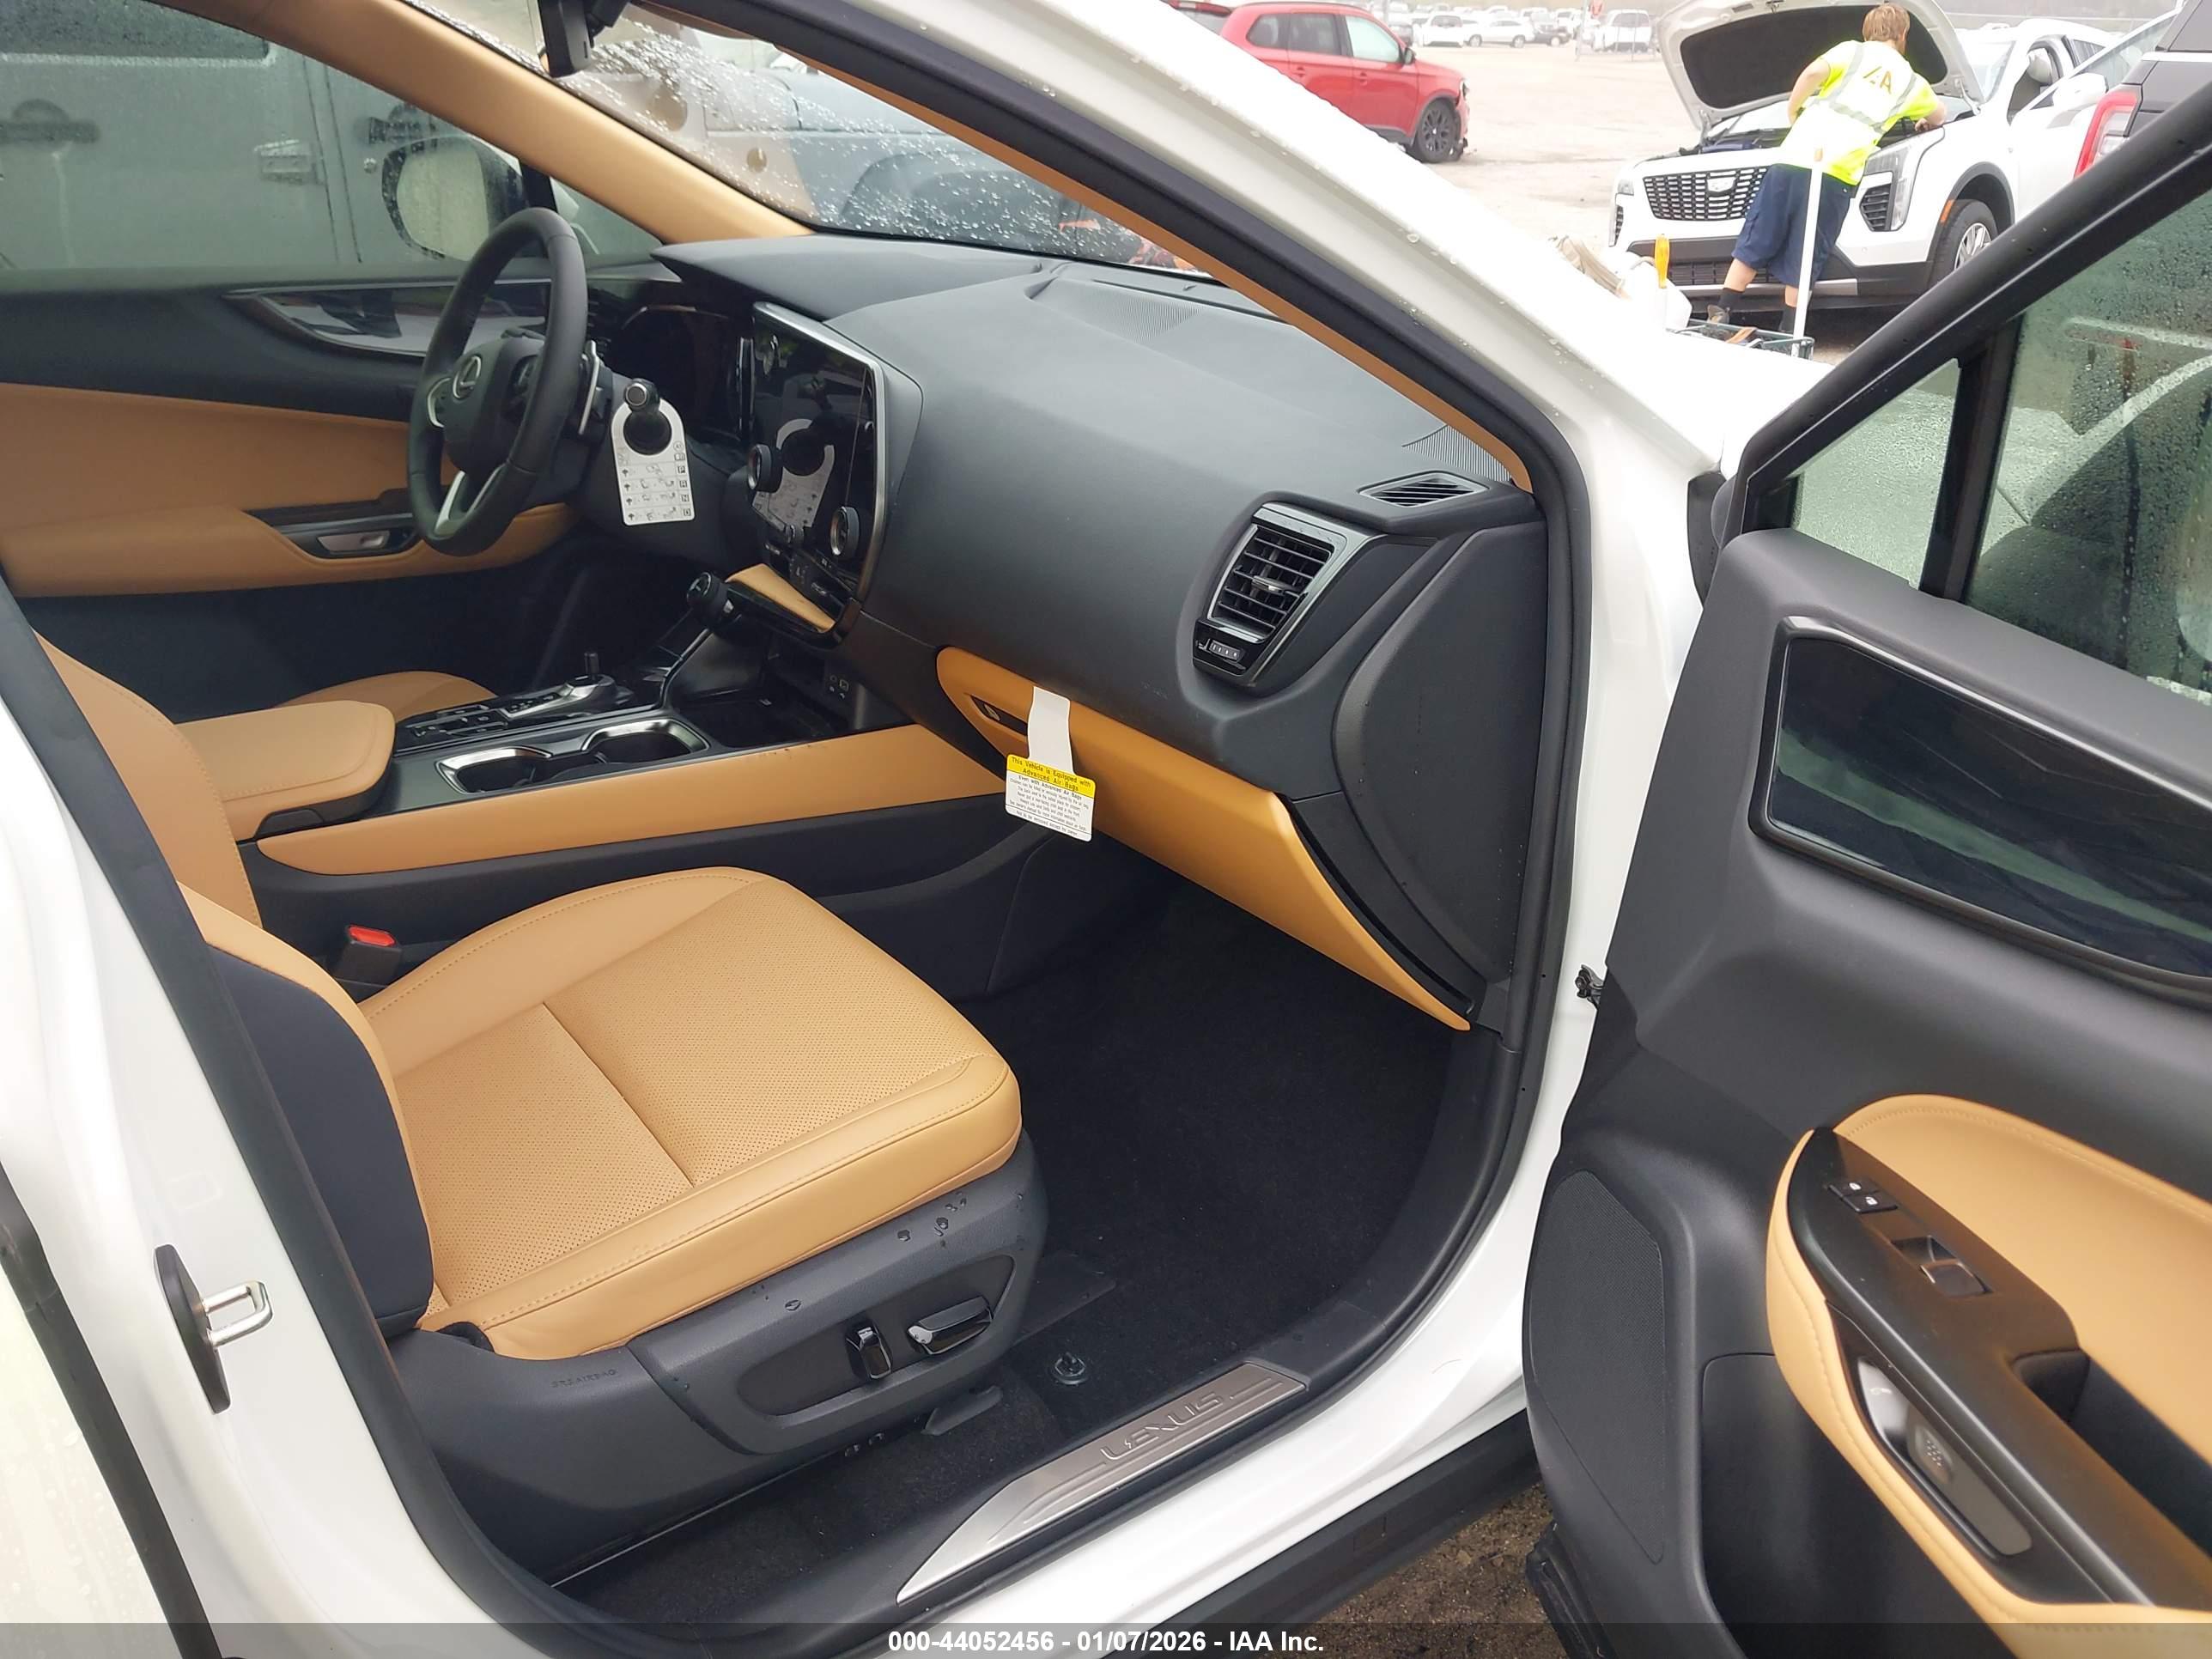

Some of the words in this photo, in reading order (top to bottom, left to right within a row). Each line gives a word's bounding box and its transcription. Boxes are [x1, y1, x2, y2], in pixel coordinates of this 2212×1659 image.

[1011, 757, 1023, 765] This
[1025, 760, 1043, 772] Vehicle
[1053, 769, 1078, 783] Equipped
[1079, 777, 1091, 787] with
[1023, 769, 1050, 781] Advanced
[1064, 781, 1079, 792] Bags
[1100, 1391, 1224, 1460] LEXUS
